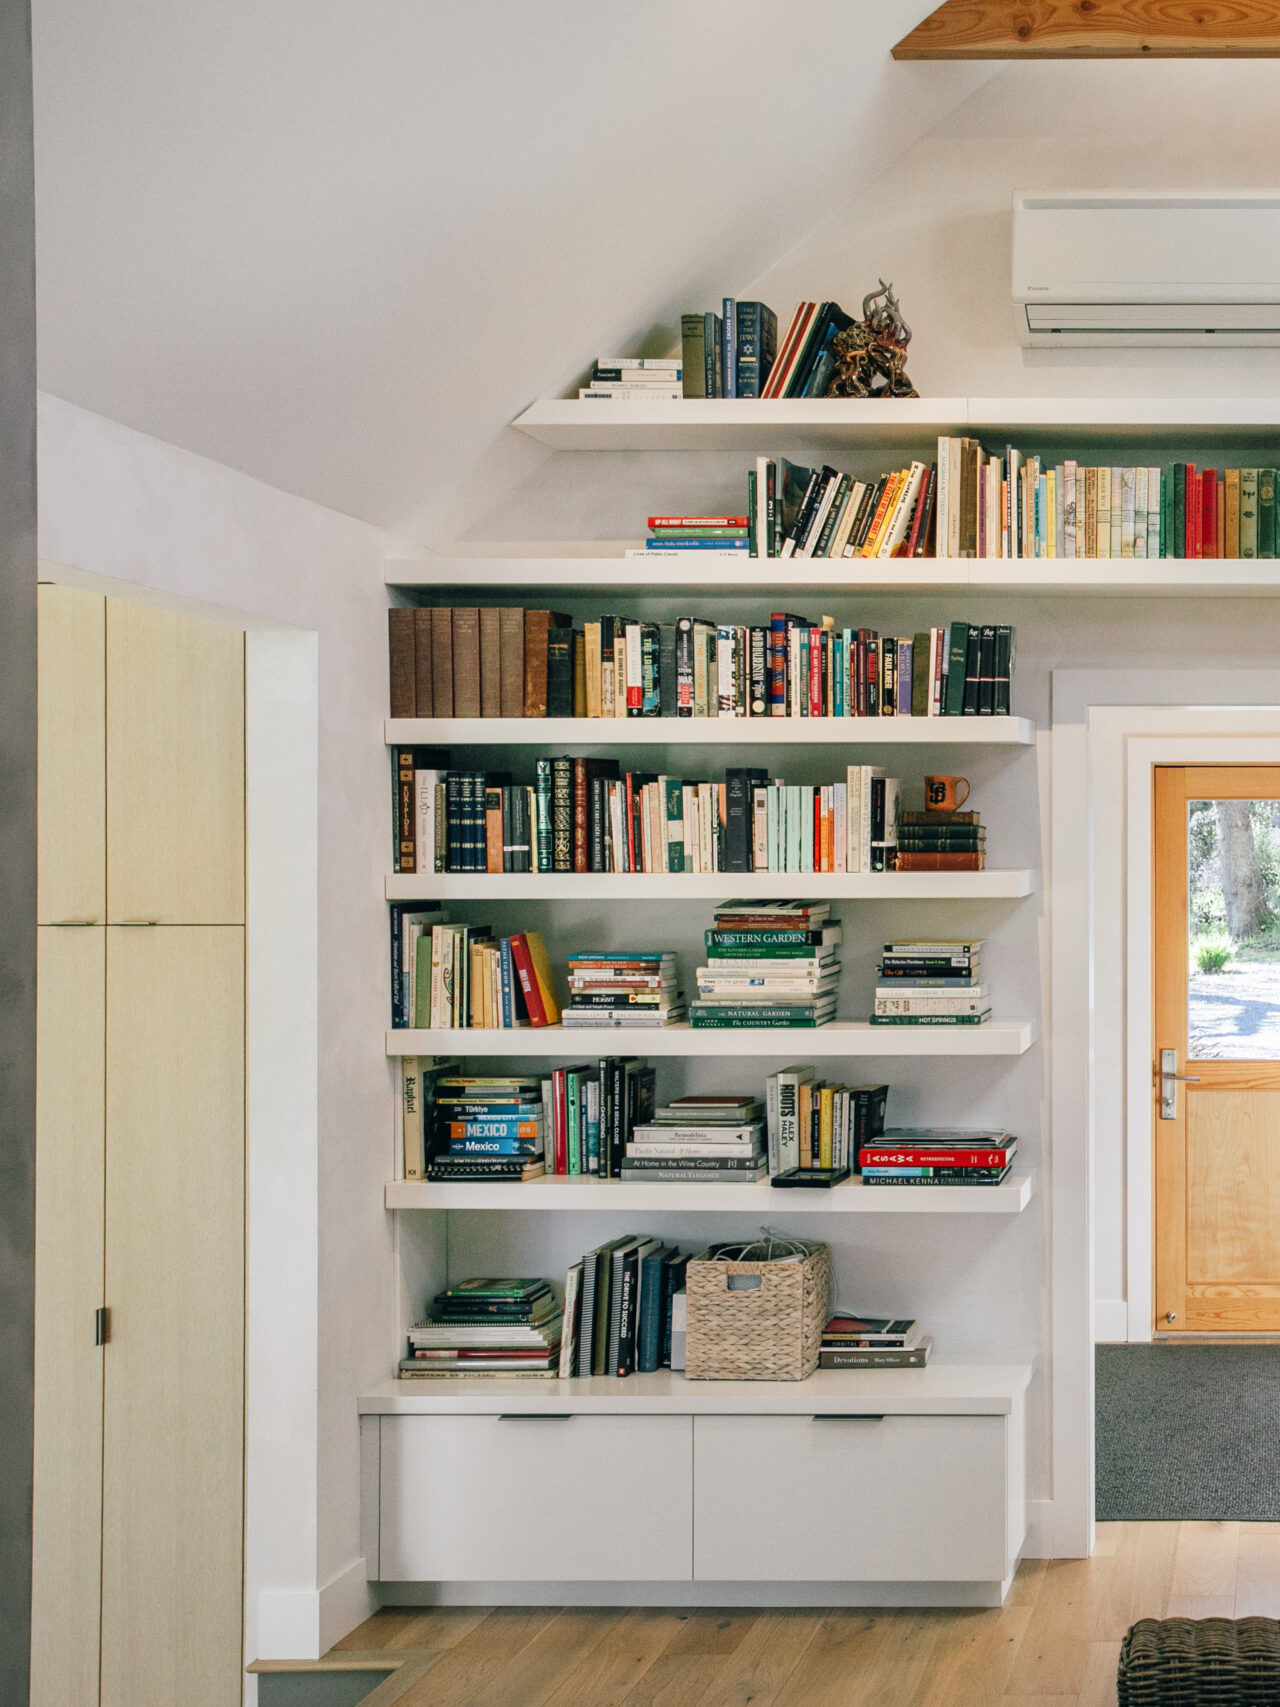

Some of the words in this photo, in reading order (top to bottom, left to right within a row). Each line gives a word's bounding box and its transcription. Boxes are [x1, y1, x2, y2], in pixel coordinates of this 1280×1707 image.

[740, 334, 758, 342] JEWS
[889, 475, 897, 486] THE
[882, 486, 893, 502] FEAST
[644, 639, 652, 652] THE
[868, 653, 876, 676] MALCOLM
[644, 655, 652, 698] LABYRINTH
[884, 653, 893, 689] FAULKNER
[714, 934, 761, 943] WESTERN
[763, 934, 806, 943] GARDEN
[502, 962, 508, 970] TO
[405, 1077, 416, 1114] Raphael
[779, 1084, 795, 1117] ROOTS
[467, 1124, 507, 1137] MEXICO
[465, 1141, 500, 1151] Mexico
[633, 1160, 640, 1169] At
[641, 1160, 660, 1169] Home
[661, 1160, 667, 1169] in
[668, 1160, 678, 1169] the
[679, 1160, 696, 1169] Wine
[697, 1160, 720, 1169] Country
[872, 1155, 914, 1163] ASAWA
[869, 1177, 909, 1185] MICHAEL
[910, 1177, 939, 1185] KENNA
[622, 1283, 630, 1302] DRIVE
[622, 1301, 629, 1310] TO
[620, 1310, 628, 1338] SUCCEED
[833, 1355, 869, 1364] Devotions
